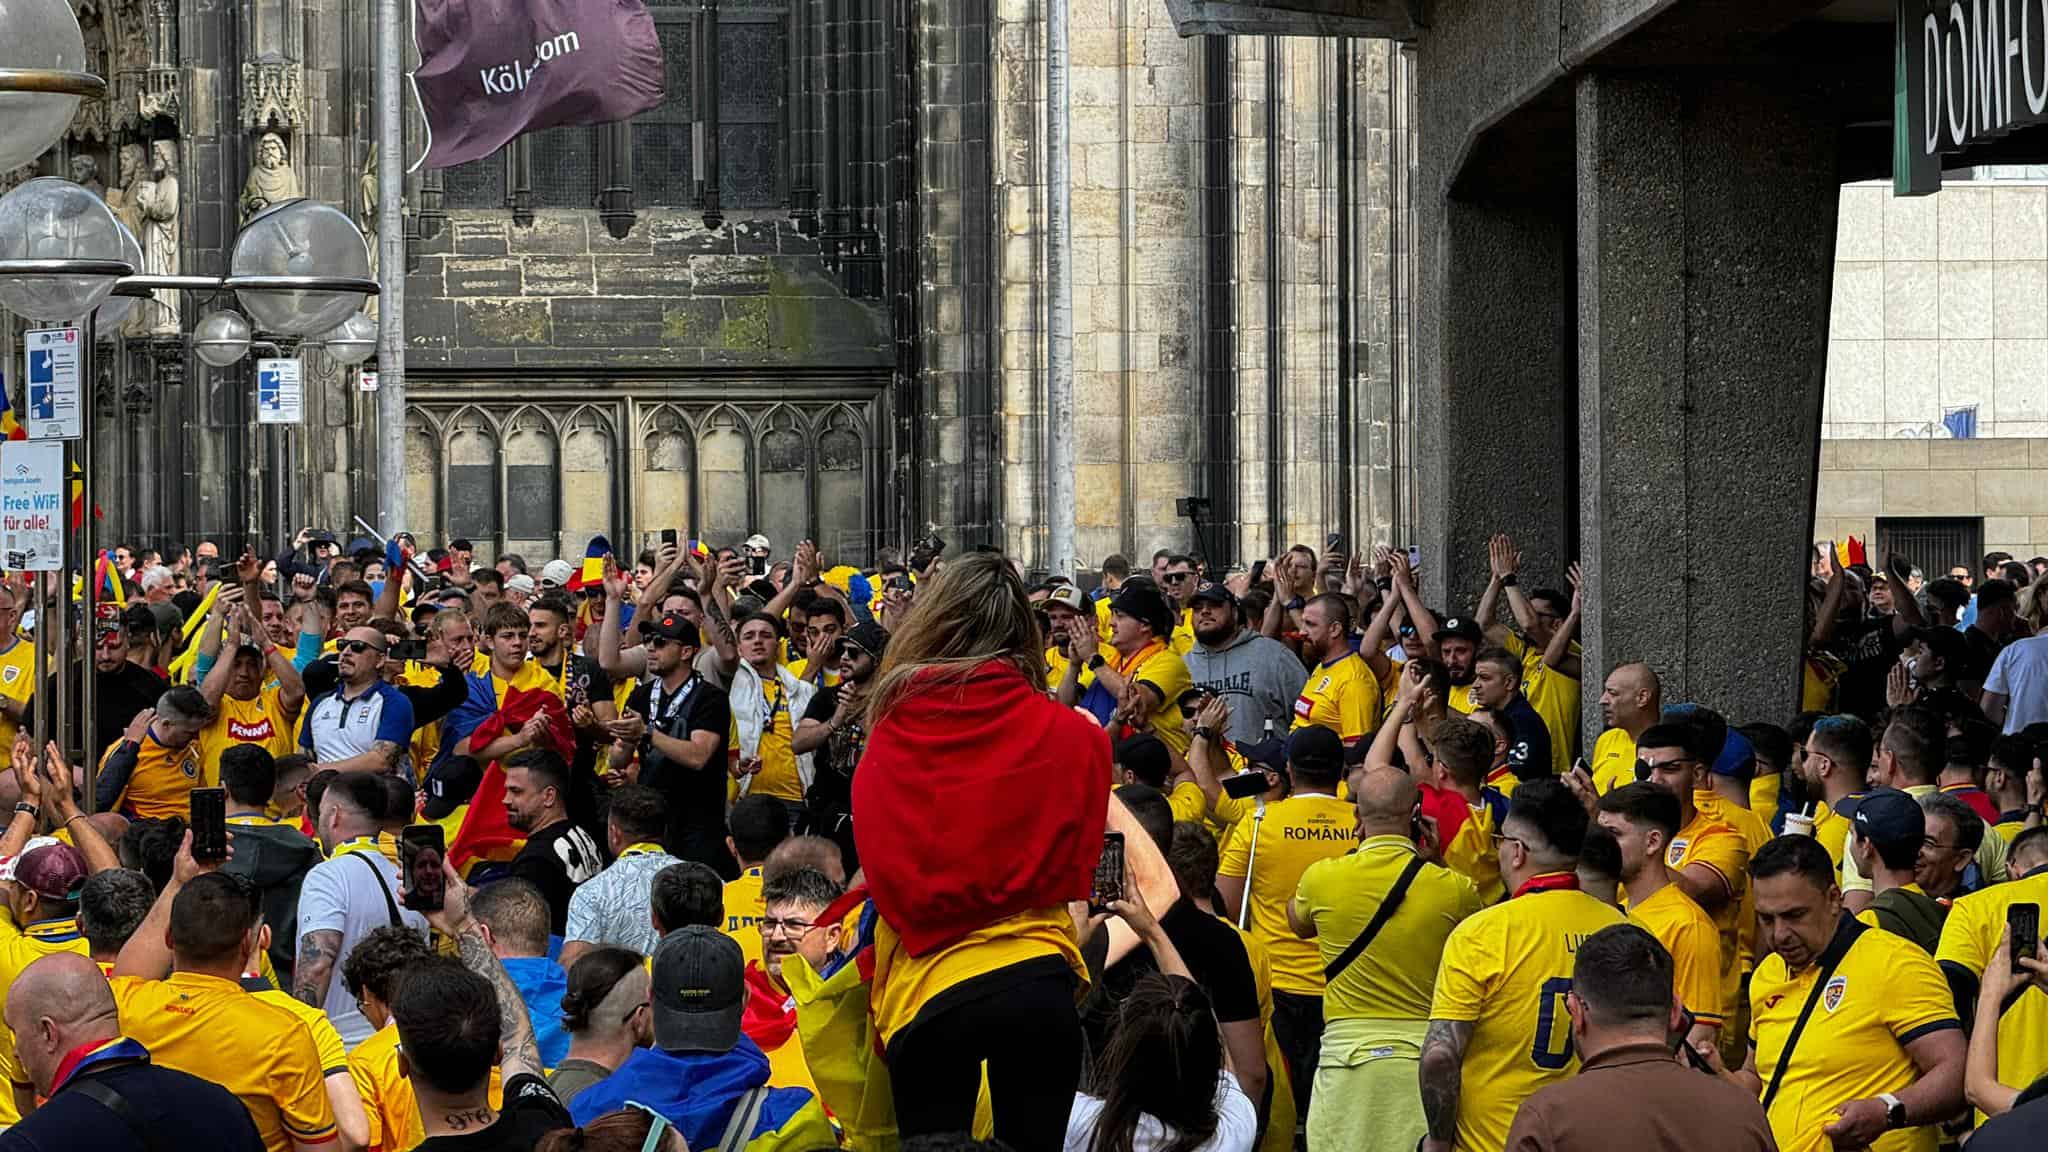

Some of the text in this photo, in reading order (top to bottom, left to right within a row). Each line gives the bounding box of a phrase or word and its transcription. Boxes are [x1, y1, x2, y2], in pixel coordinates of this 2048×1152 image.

[4, 493, 59, 511] Free WiFi
[4, 514, 49, 531] für alle!
